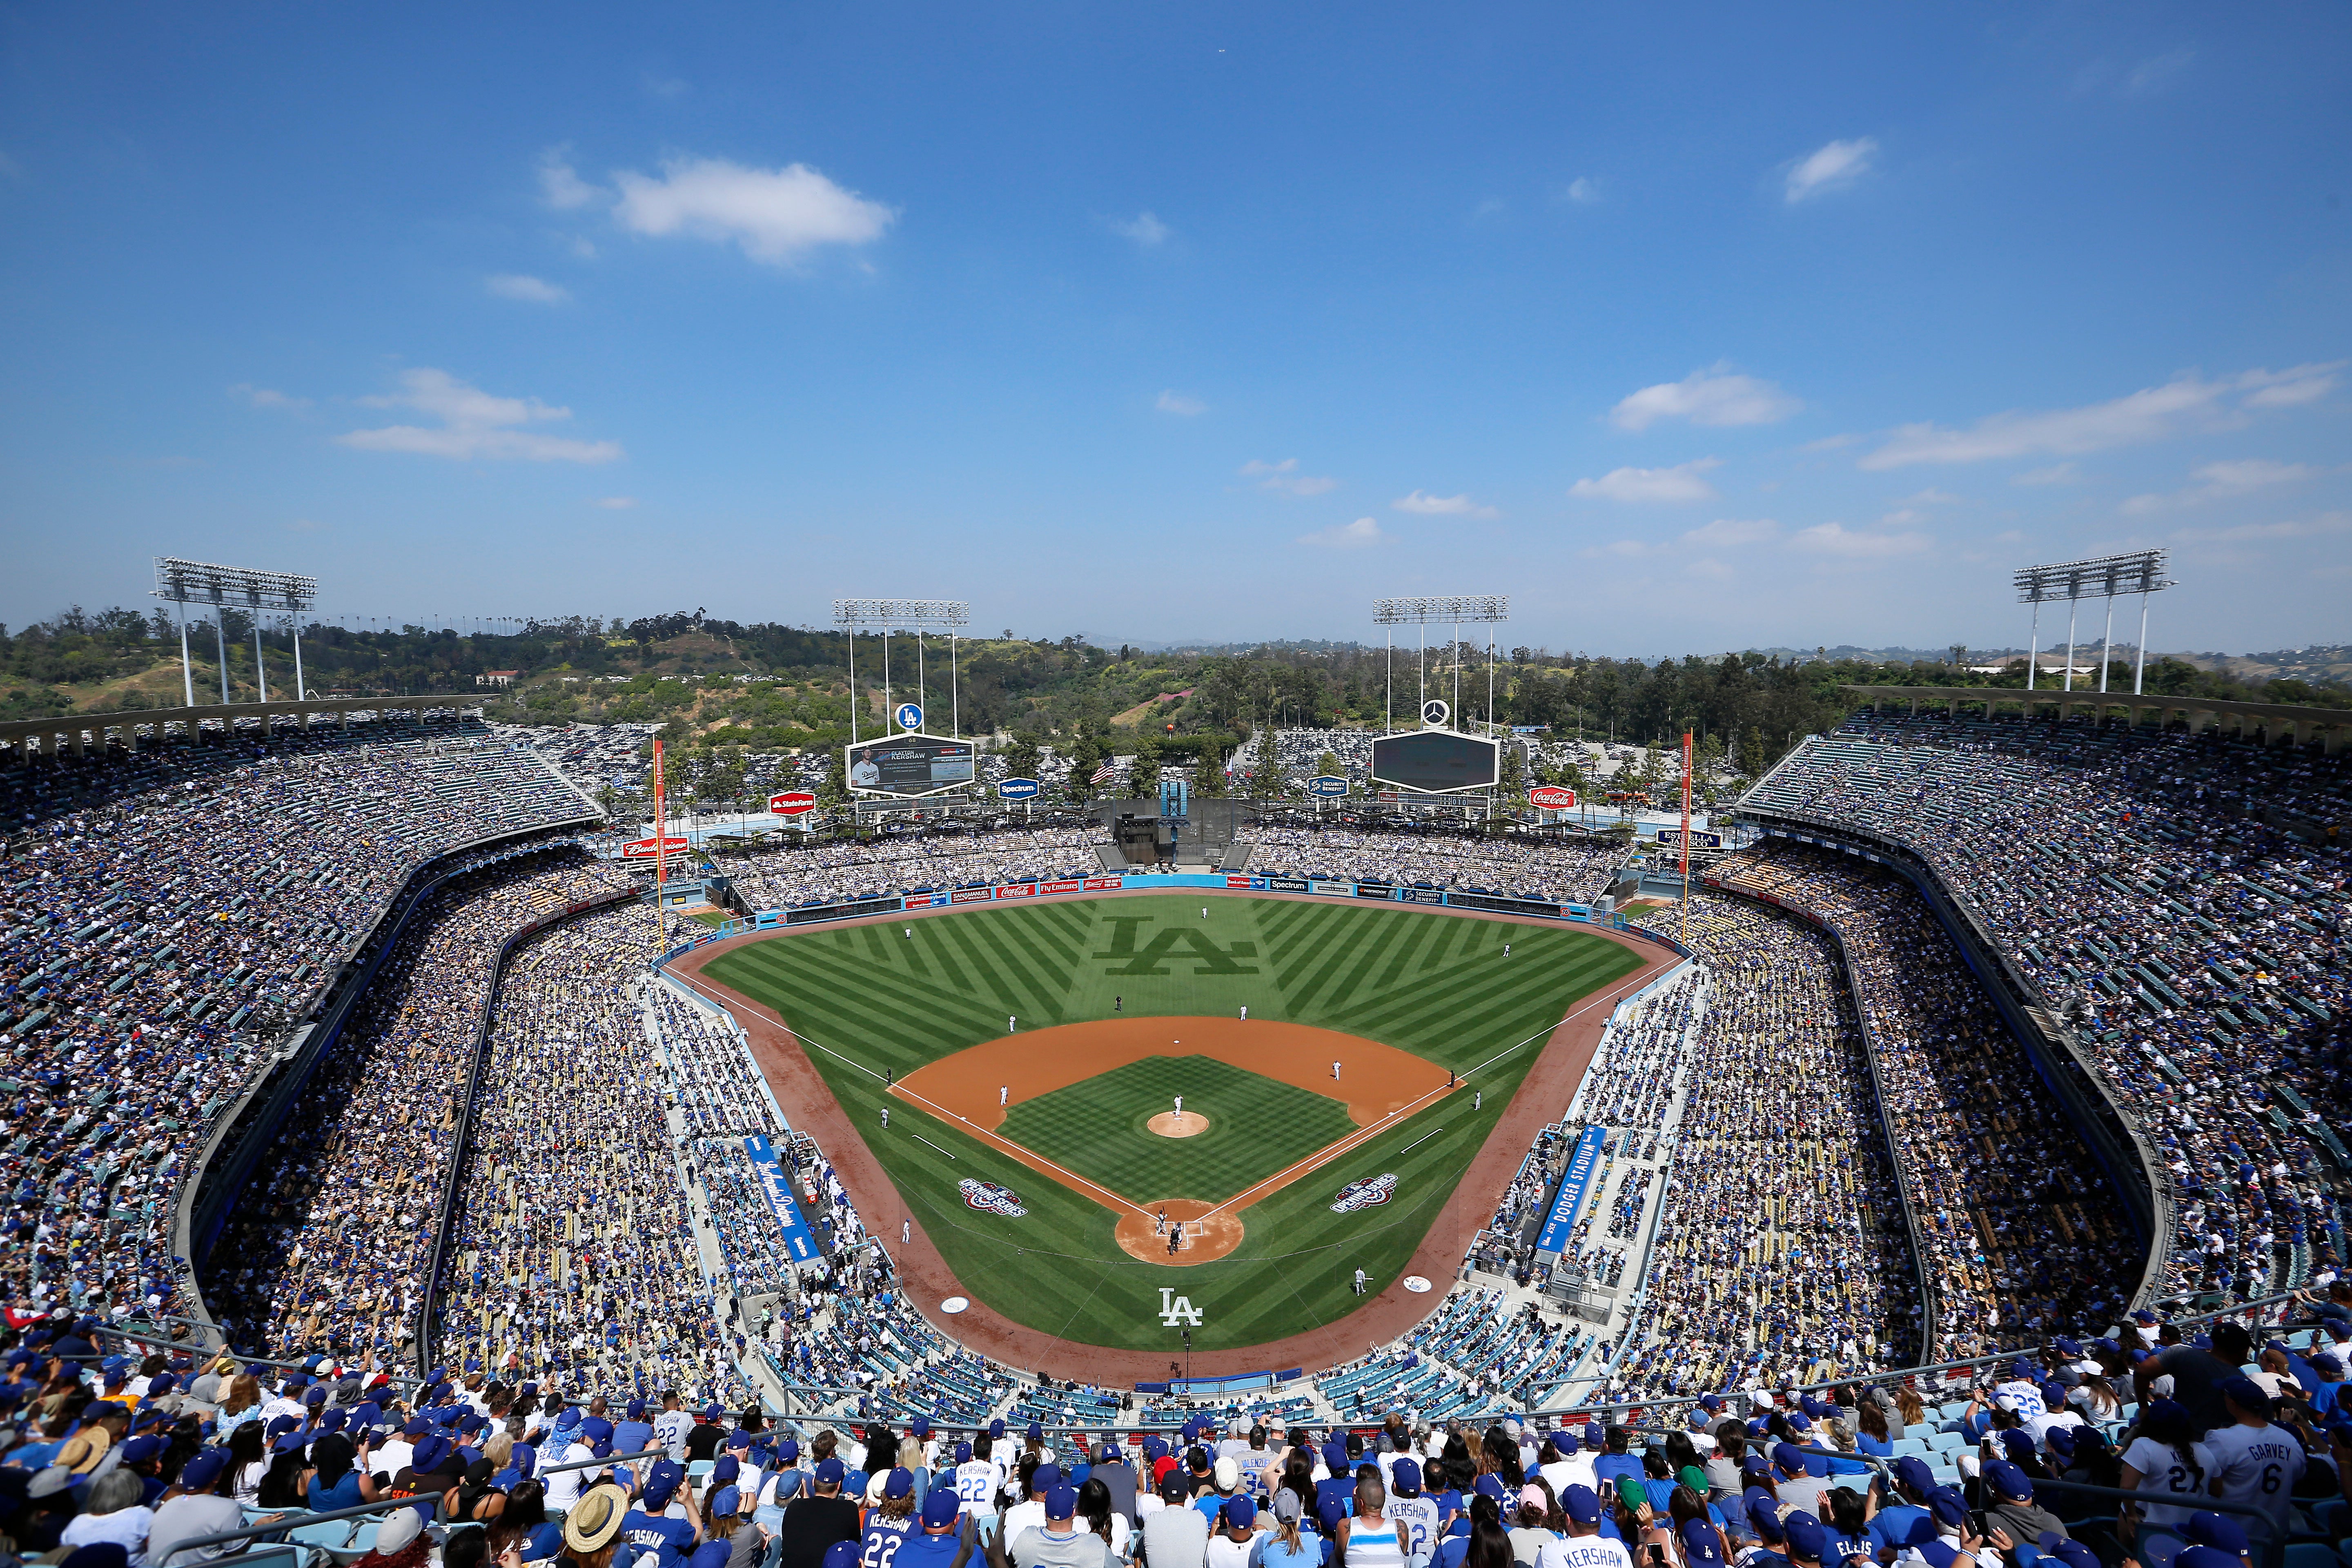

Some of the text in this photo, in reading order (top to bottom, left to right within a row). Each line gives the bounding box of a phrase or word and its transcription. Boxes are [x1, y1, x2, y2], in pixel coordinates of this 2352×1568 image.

[904, 708, 917, 726] LA
[1002, 785, 1033, 794] Spectrum
[1533, 791, 1571, 805] Coca-Cola
[1664, 831, 1713, 842] ESTELLA
[1669, 839, 1708, 847] JASCO
[626, 841, 686, 855] Budeiser
[1001, 886, 1030, 898] Coca-Cola
[1272, 881, 1305, 889] Spectrum
[1729, 883, 1741, 893] BUD'S
[906, 893, 946, 902] #MLBmemorybank
[798, 912, 834, 921] MBSoCal.com
[1524, 906, 1560, 915] MBSoCal.com
[1091, 915, 1259, 975] LA
[1553, 1144, 1596, 1223] DODGER STADIUM
[960, 1178, 1026, 1216] OPENING SERIES
[1332, 1174, 1397, 1212] OPENING SERIES
[772, 1196, 795, 1227] Dodgers
[793, 1236, 808, 1257] Spectrum
[1158, 1287, 1203, 1326] LA
[2008, 1385, 2040, 1397] KERSHAW
[2013, 1394, 2041, 1417] 22
[657, 1417, 682, 1428] KERSHAW
[657, 1426, 677, 1446] 22
[539, 1452, 569, 1465] SEAGR
[2248, 1443, 2291, 1461] GARVEY
[960, 1465, 992, 1477] KERSHAW
[2261, 1463, 2282, 1494] 6
[960, 1478, 987, 1502] 22
[1388, 1503, 1429, 1522] KERSHAW
[869, 1513, 912, 1534] KERSHAW
[626, 1529, 666, 1550] ERSHAW
[1835, 1540, 1873, 1557] ELLIS
[864, 1532, 902, 1568] 22
[1564, 1548, 1622, 1568] KERSHAW
[1704, 1545, 1713, 1558] LA
